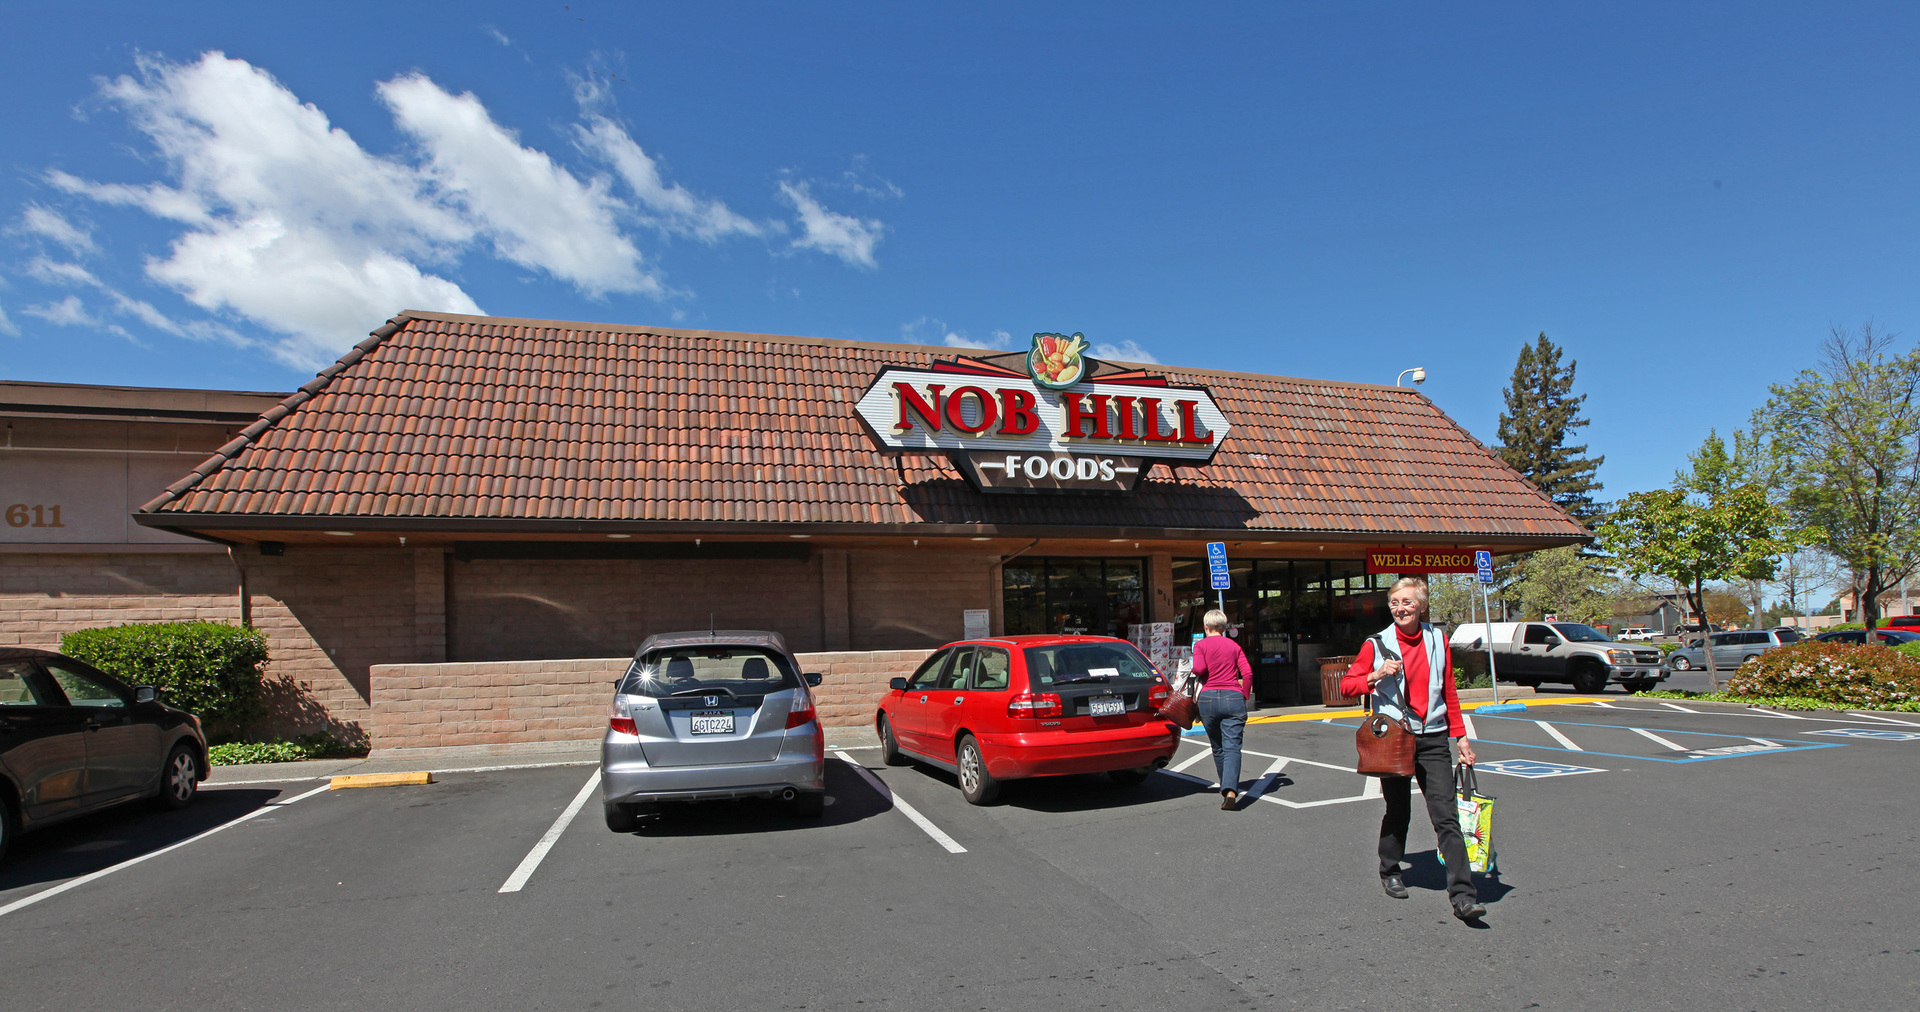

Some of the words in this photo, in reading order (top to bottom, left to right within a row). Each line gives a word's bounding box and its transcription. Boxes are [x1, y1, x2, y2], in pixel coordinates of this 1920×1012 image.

[888, 382, 1040, 437] NOB
[1059, 391, 1214, 445] HILL
[1005, 455, 1116, 481] FOODS
[5, 503, 66, 528] 611
[1372, 554, 1422, 567] WELLS
[1424, 554, 1471, 567] FARGO
[693, 719, 732, 730] 6GTC224
